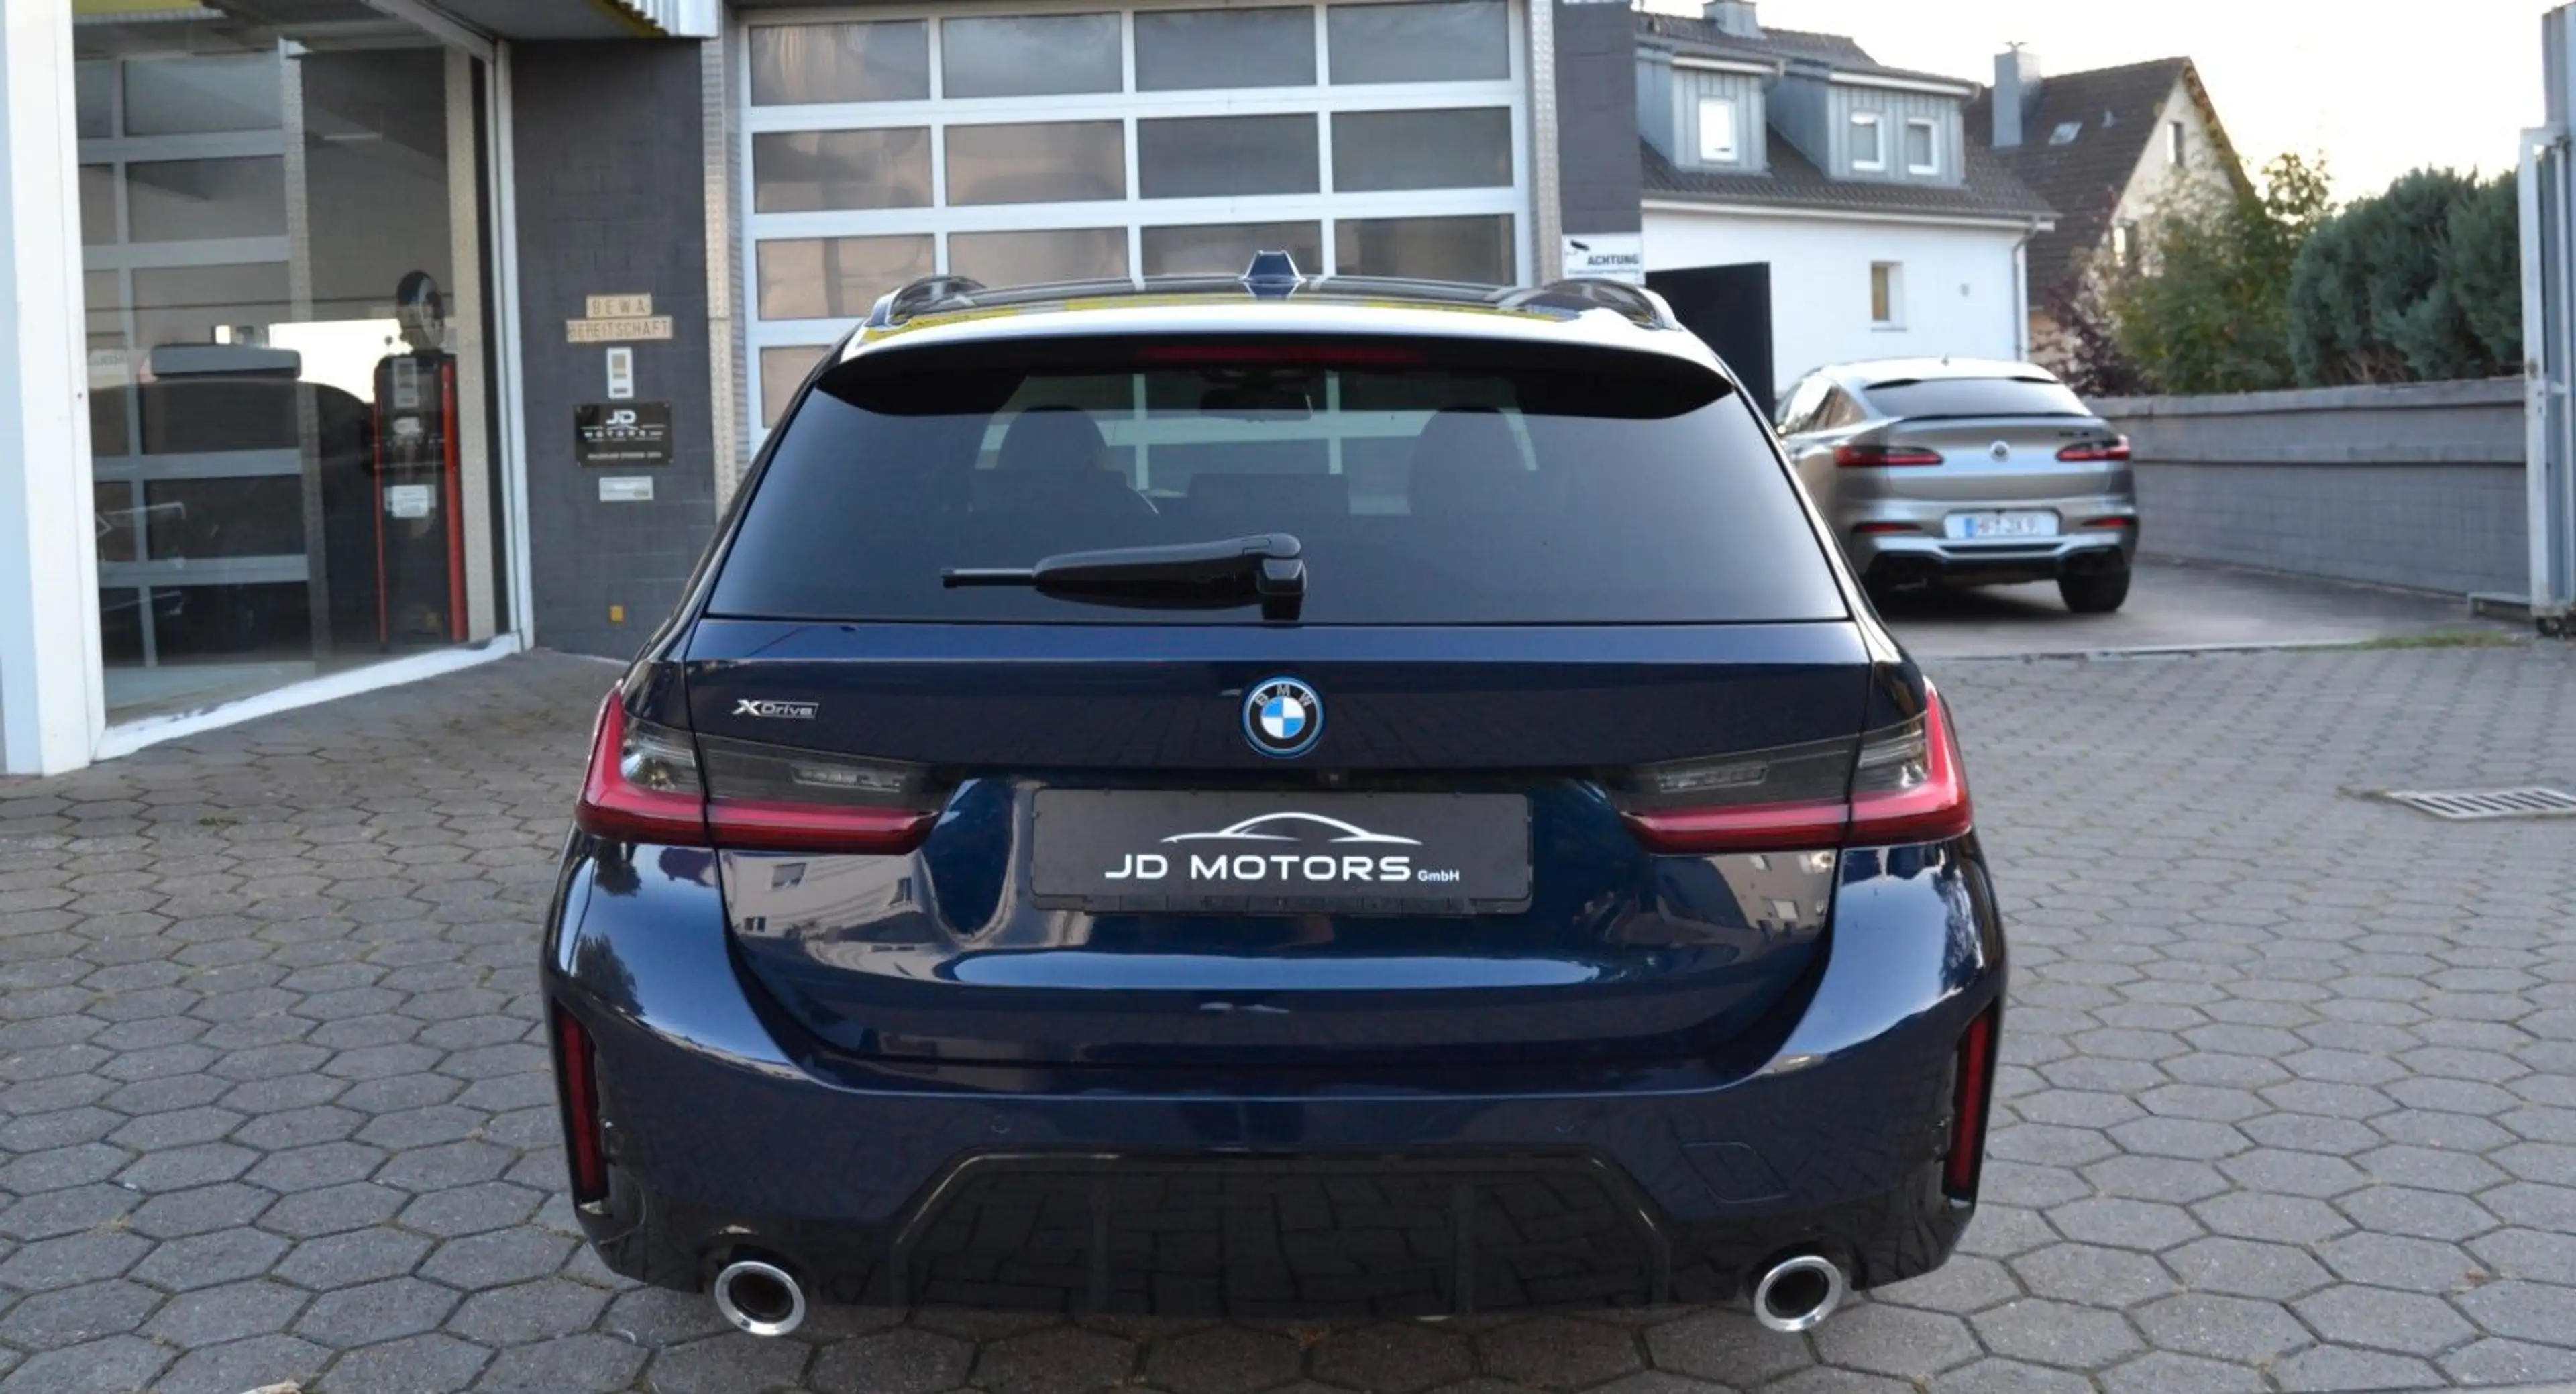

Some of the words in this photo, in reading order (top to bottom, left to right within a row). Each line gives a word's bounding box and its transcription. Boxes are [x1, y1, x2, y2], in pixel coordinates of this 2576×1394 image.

[1587, 254, 1639, 265] ACHTUNG
[568, 319, 668, 339] BEREITSCHAFT
[606, 409, 636, 425] JD
[1255, 684, 1314, 706] BMW
[1105, 854, 1168, 879] JD
[1191, 855, 1411, 881] MOTORS
[1417, 869, 1460, 883] GmbH
